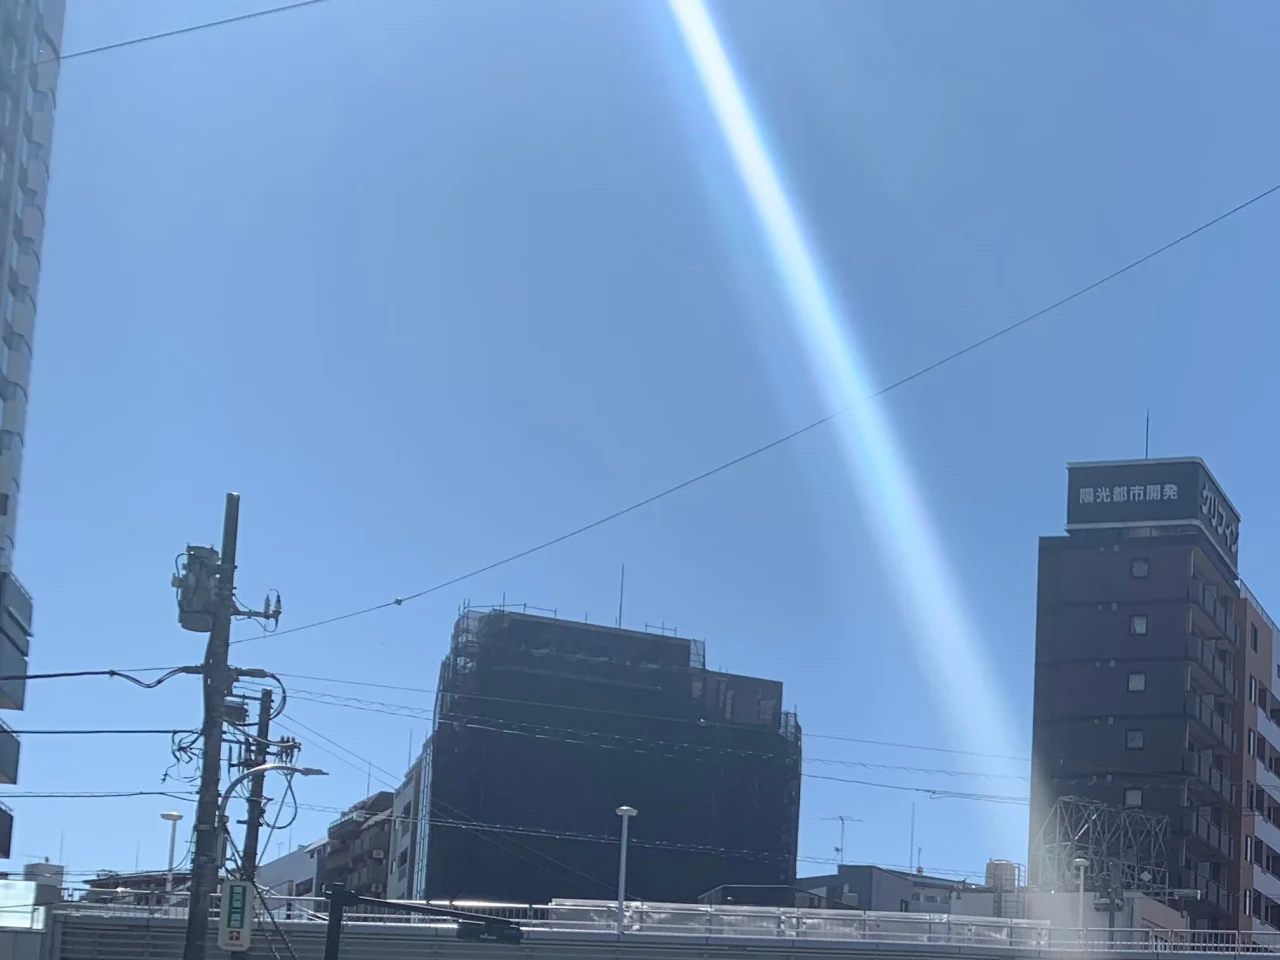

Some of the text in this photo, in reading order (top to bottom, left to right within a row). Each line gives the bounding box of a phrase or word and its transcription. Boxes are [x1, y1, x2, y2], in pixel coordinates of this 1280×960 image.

[1079, 484, 1178, 504] 陽光都市開発
